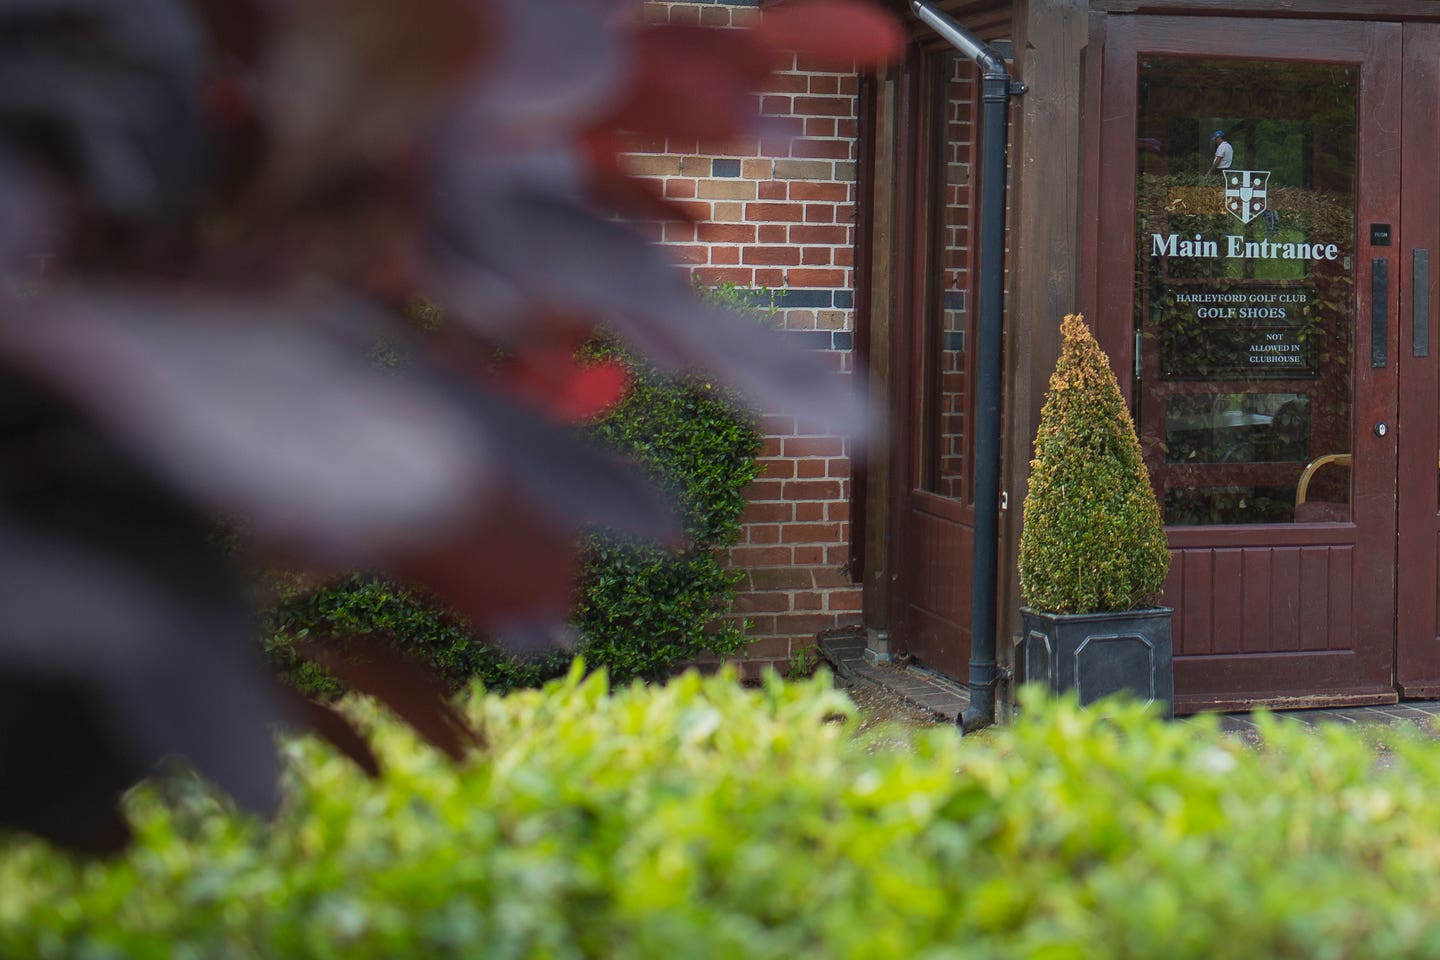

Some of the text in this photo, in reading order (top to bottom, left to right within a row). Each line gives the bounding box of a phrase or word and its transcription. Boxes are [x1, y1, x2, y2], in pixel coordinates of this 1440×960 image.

[1151, 233, 1338, 261] Main Entrance
[1176, 294, 1307, 303] HARLEYFORD GOLF CLUB
[1197, 307, 1286, 319] GOLF SHOES
[1266, 333, 1284, 341] NOT
[1249, 344, 1300, 352] ALLOWED IN
[1249, 355, 1300, 363] CLUBHOUSE
